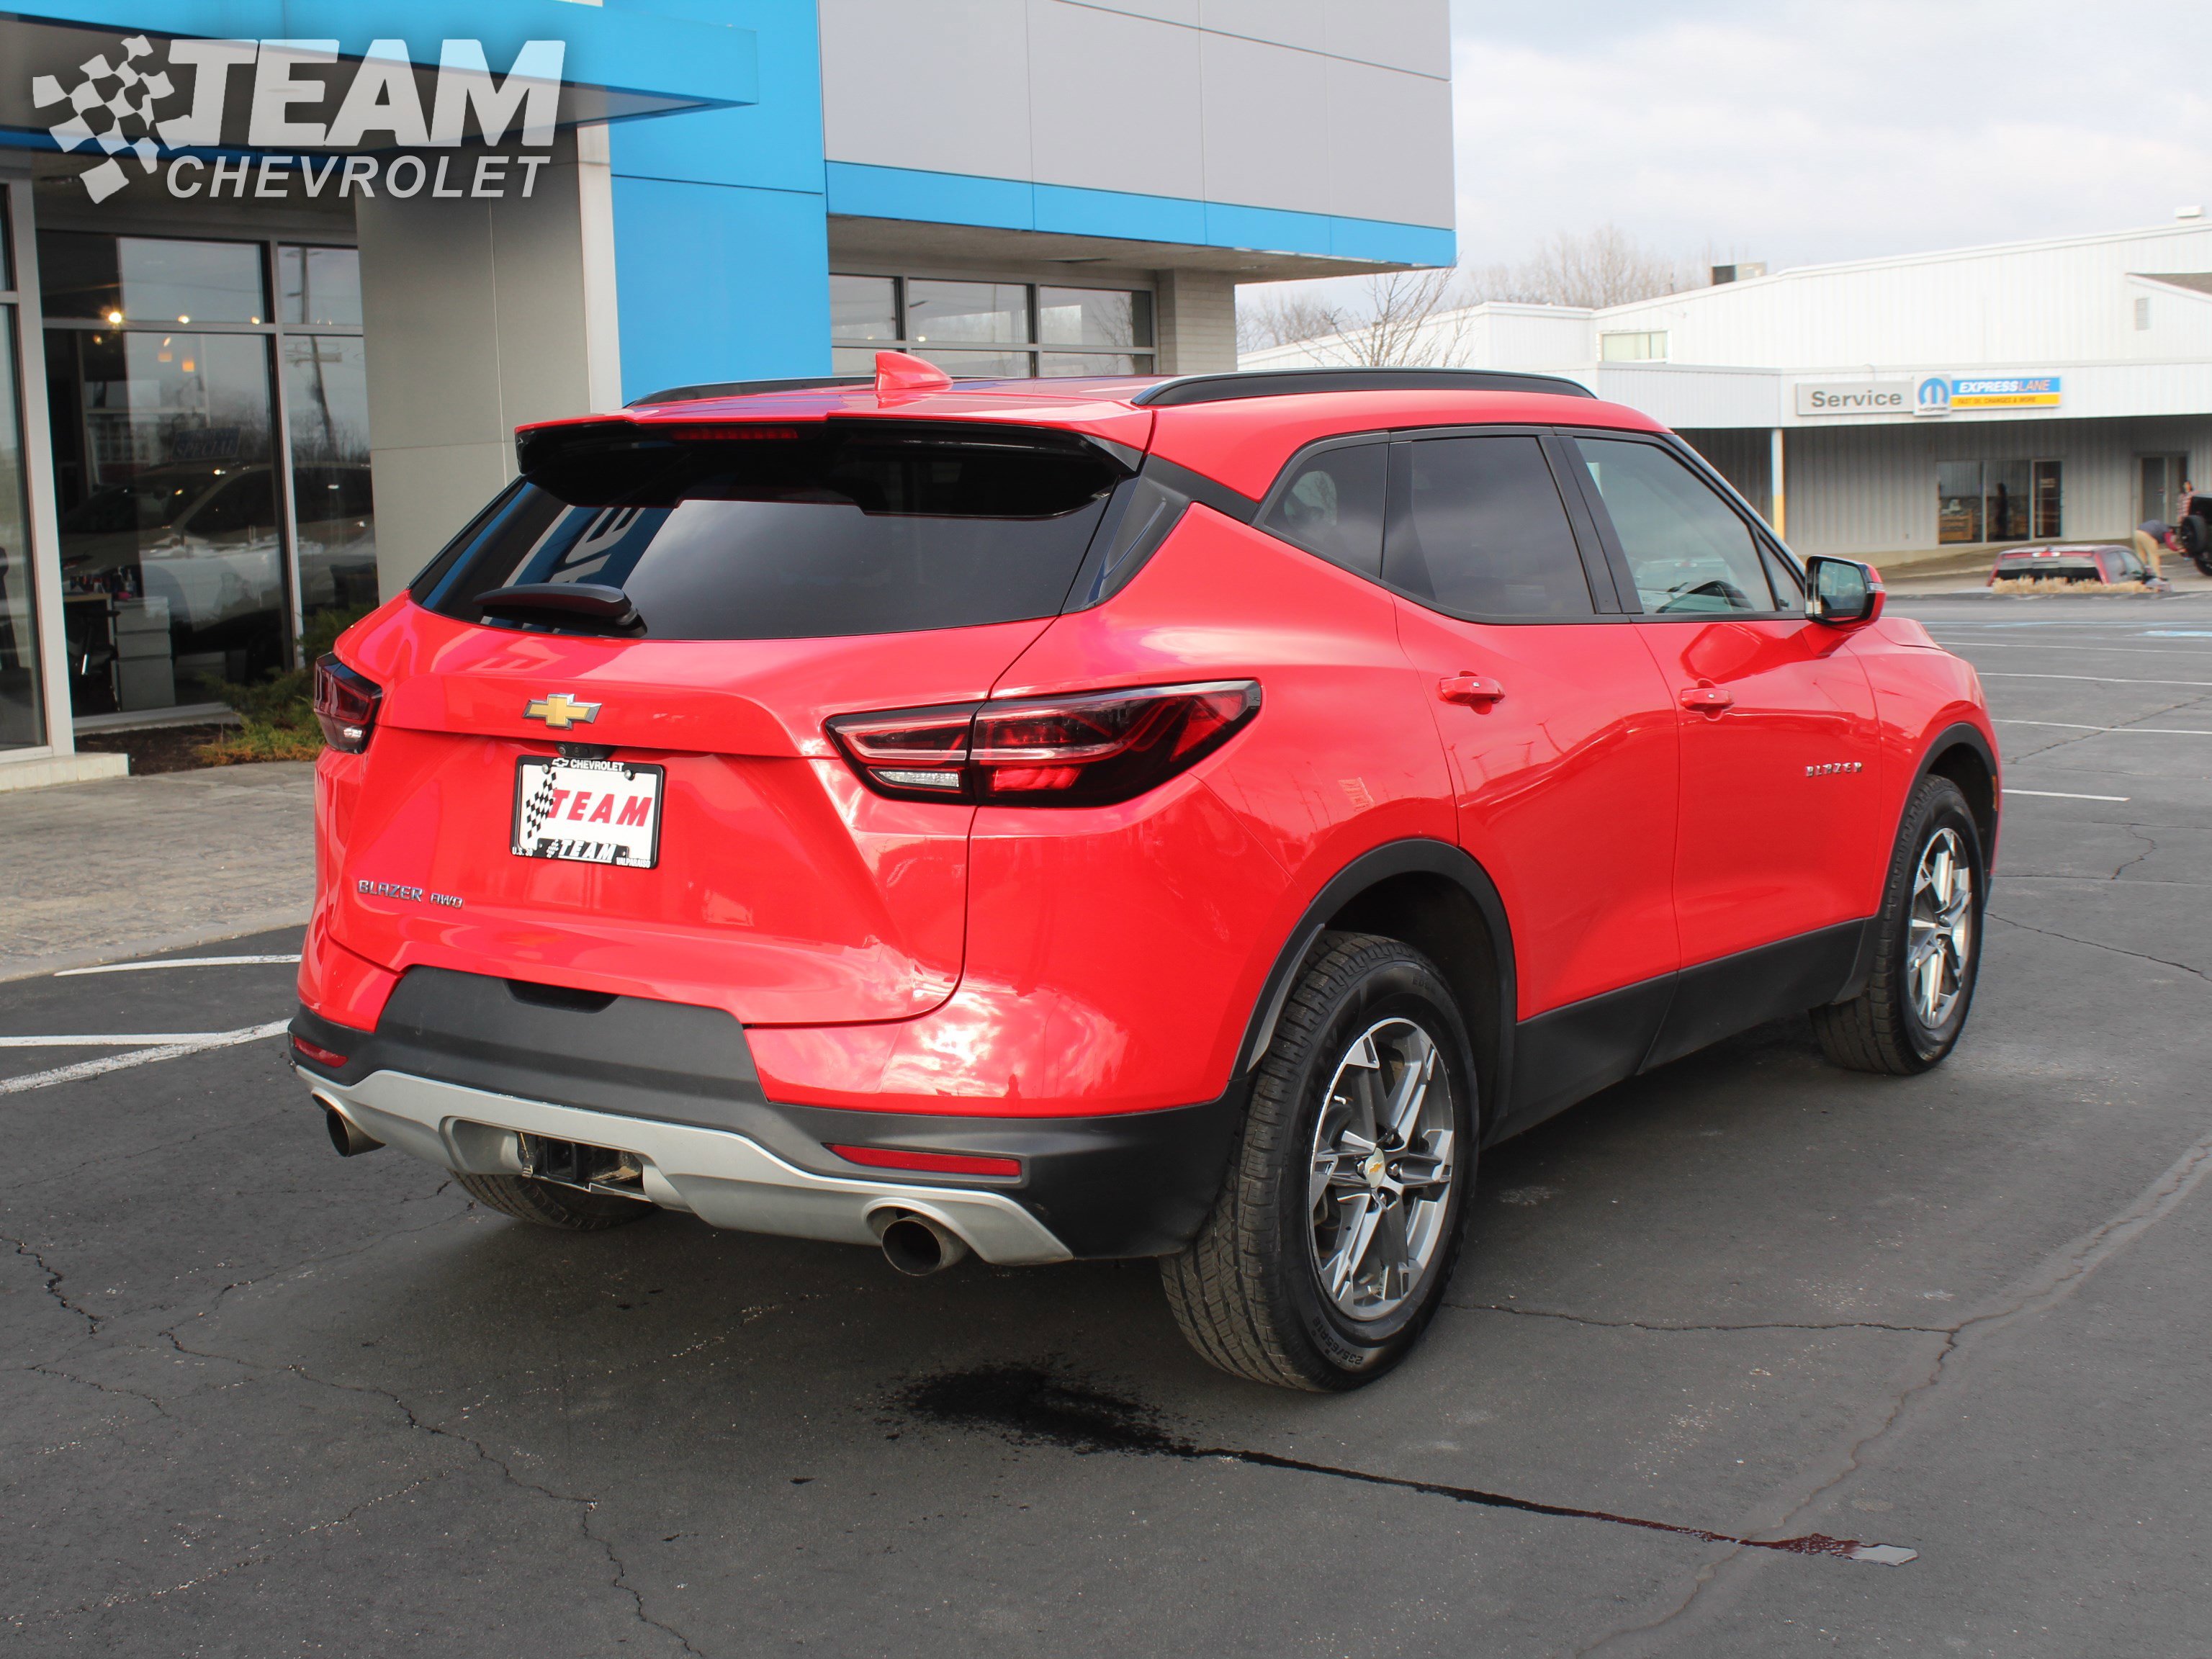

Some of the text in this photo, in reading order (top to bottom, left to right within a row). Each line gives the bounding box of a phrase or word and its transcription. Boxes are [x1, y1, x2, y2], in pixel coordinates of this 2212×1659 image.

[1811, 390, 1903, 408] Service
[570, 758, 624, 772] CHEVROLET
[1805, 762, 1862, 777] BLAZER
[547, 788, 652, 827] TEAM
[512, 845, 524, 855] U.S.
[558, 839, 617, 862] TEAM
[616, 856, 651, 868] VALPARAISO
[358, 879, 464, 909] BLAZER AWD
